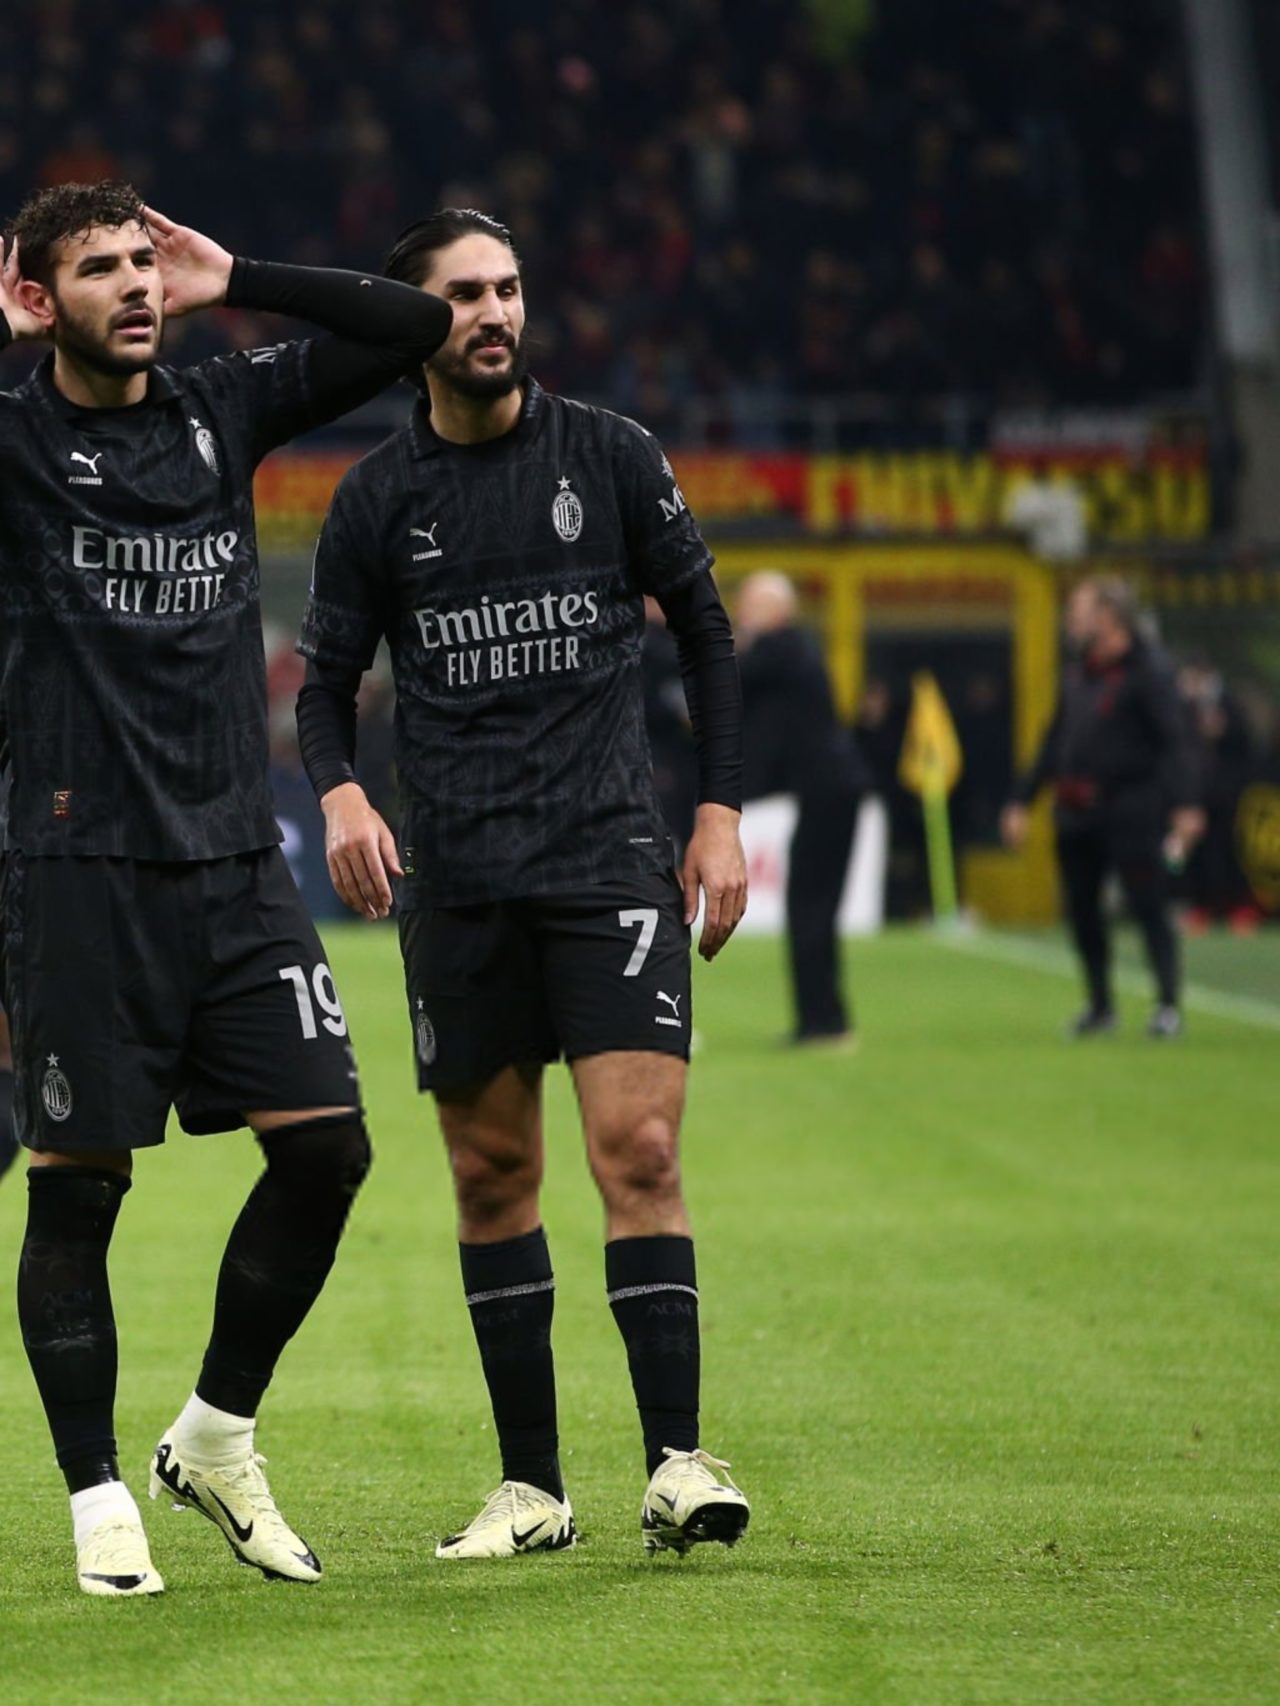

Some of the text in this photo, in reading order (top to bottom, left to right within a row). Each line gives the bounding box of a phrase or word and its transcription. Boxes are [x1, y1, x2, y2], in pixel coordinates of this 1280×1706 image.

[71, 525, 239, 572] Emirate
[105, 573, 225, 614] FLY BETTE
[414, 590, 599, 649] Emirates
[447, 636, 580, 687] FLY BETTER
[618, 909, 659, 976] 7
[278, 962, 347, 1040] 19
